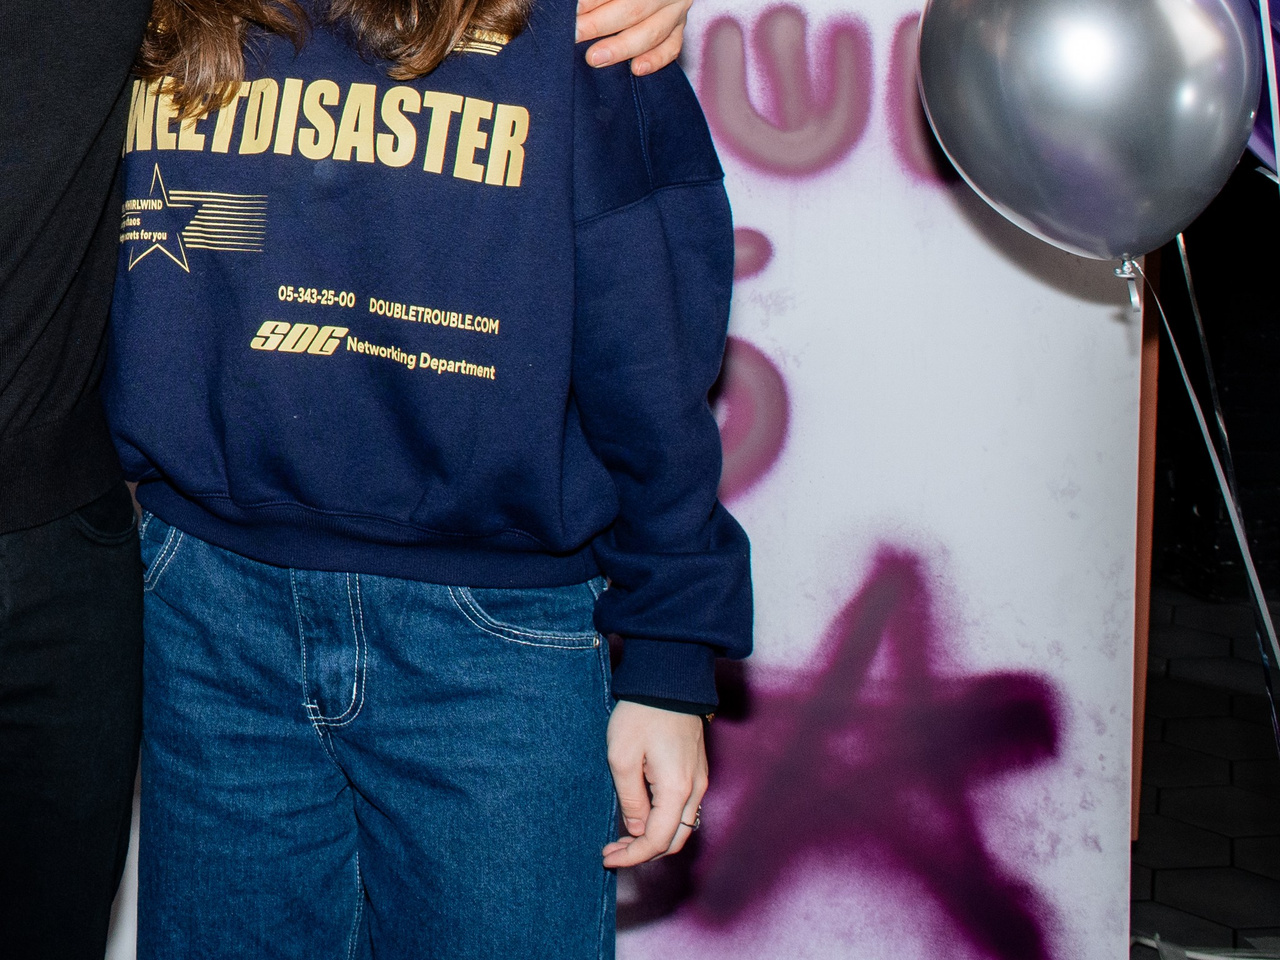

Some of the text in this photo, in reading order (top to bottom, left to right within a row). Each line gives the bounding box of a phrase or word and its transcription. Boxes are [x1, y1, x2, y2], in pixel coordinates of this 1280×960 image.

[122, 76, 529, 187] WEETDISASTER
[140, 229, 152, 240] for
[152, 231, 168, 243] you
[278, 285, 500, 335] 05-343-25-00 DOUBLETROUBLE.COM
[250, 320, 496, 380] SDG Networking Department
